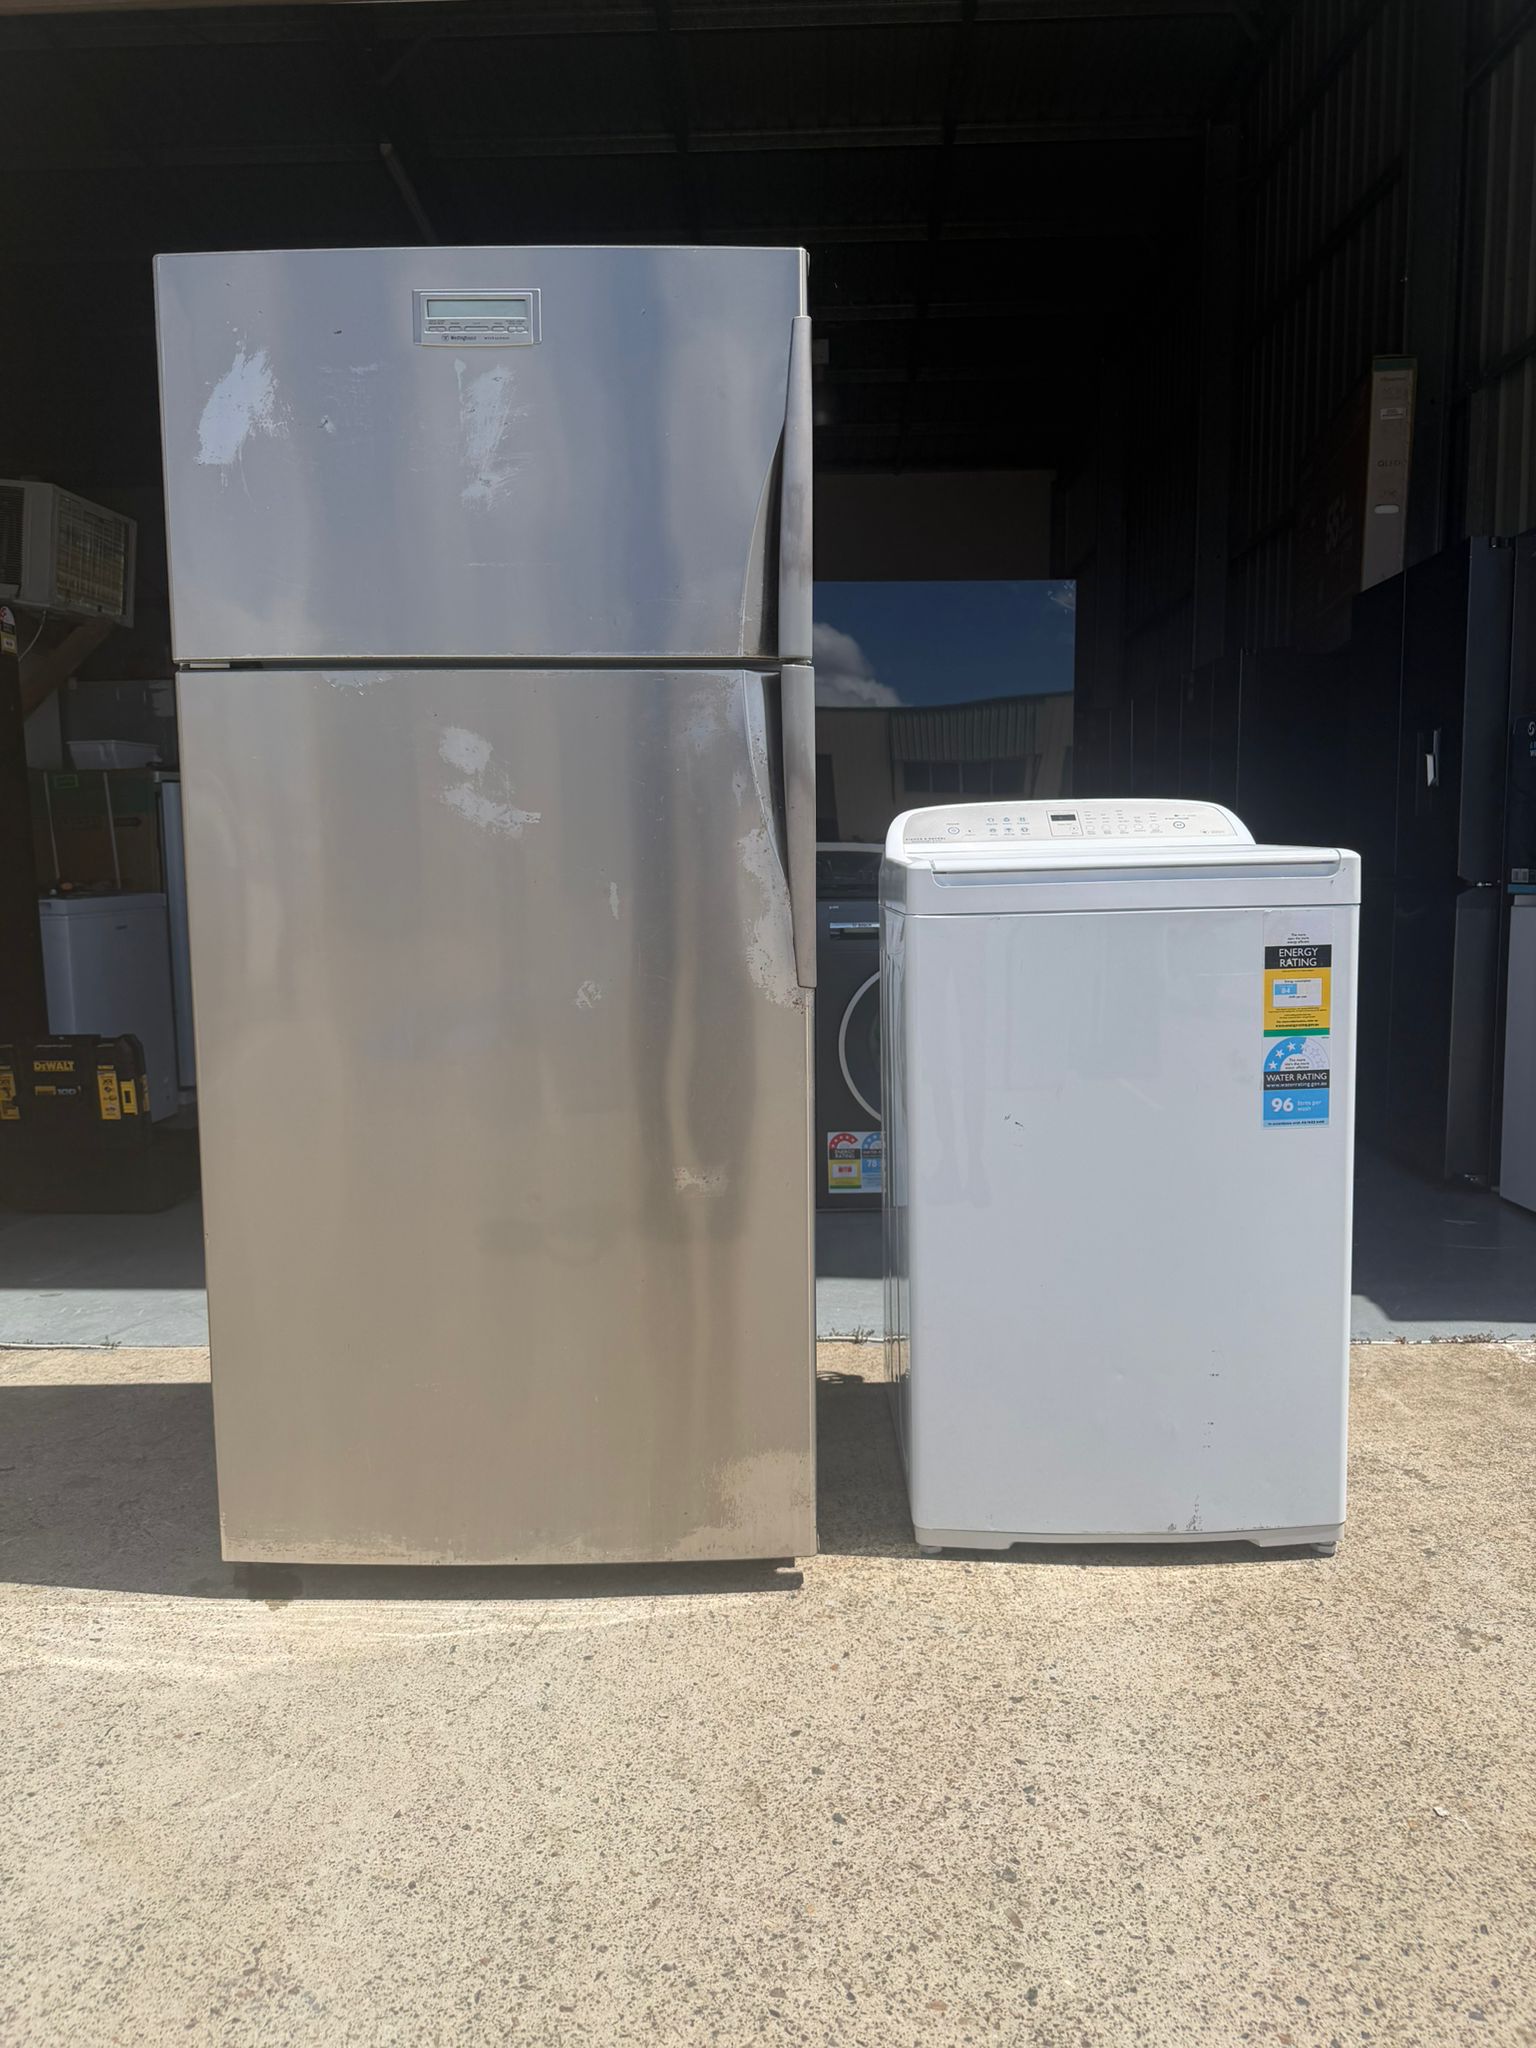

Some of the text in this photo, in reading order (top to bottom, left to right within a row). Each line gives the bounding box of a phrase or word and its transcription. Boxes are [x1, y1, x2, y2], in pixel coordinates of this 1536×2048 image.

[1279, 947, 1318, 957] ENERGY
[1280, 957, 1317, 967] RATING
[1266, 1072, 1328, 1082] WATER RATING
[1271, 1097, 1294, 1112] 96
